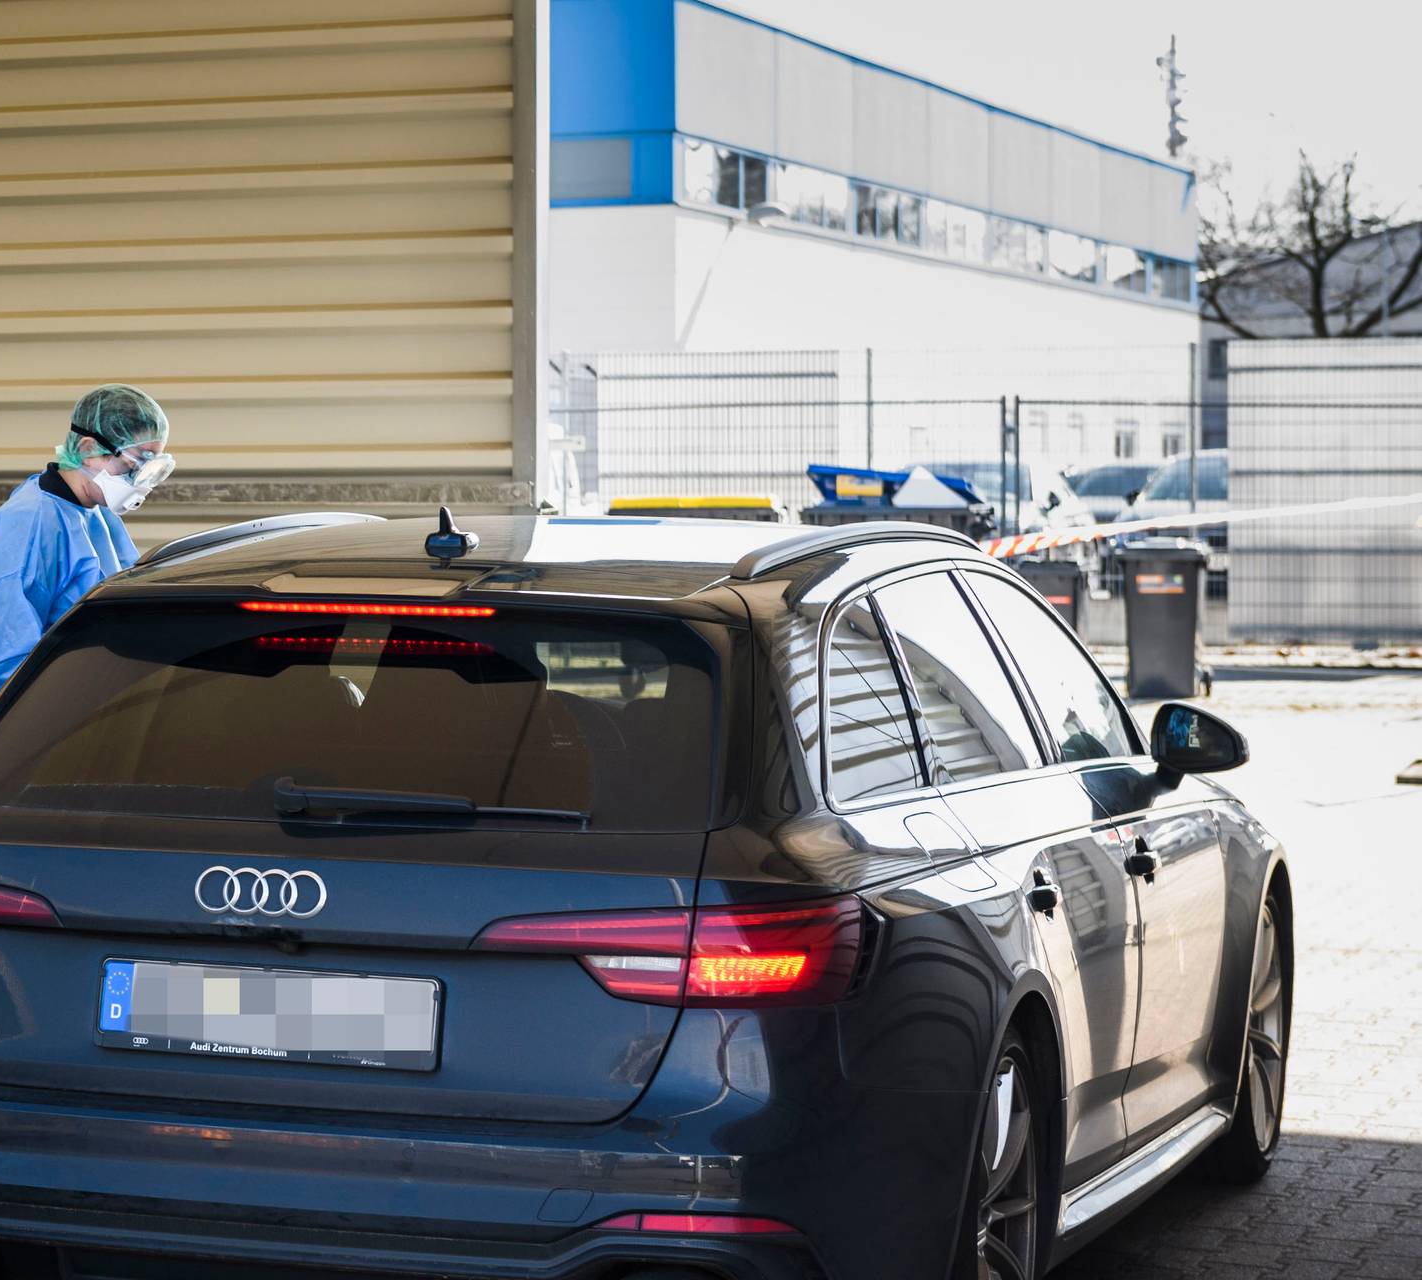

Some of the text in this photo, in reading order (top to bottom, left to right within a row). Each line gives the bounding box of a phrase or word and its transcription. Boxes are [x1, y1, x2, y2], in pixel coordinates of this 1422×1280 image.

[110, 1003, 122, 1019] D
[190, 1041, 287, 1057] Audi Zentrum Bochum
